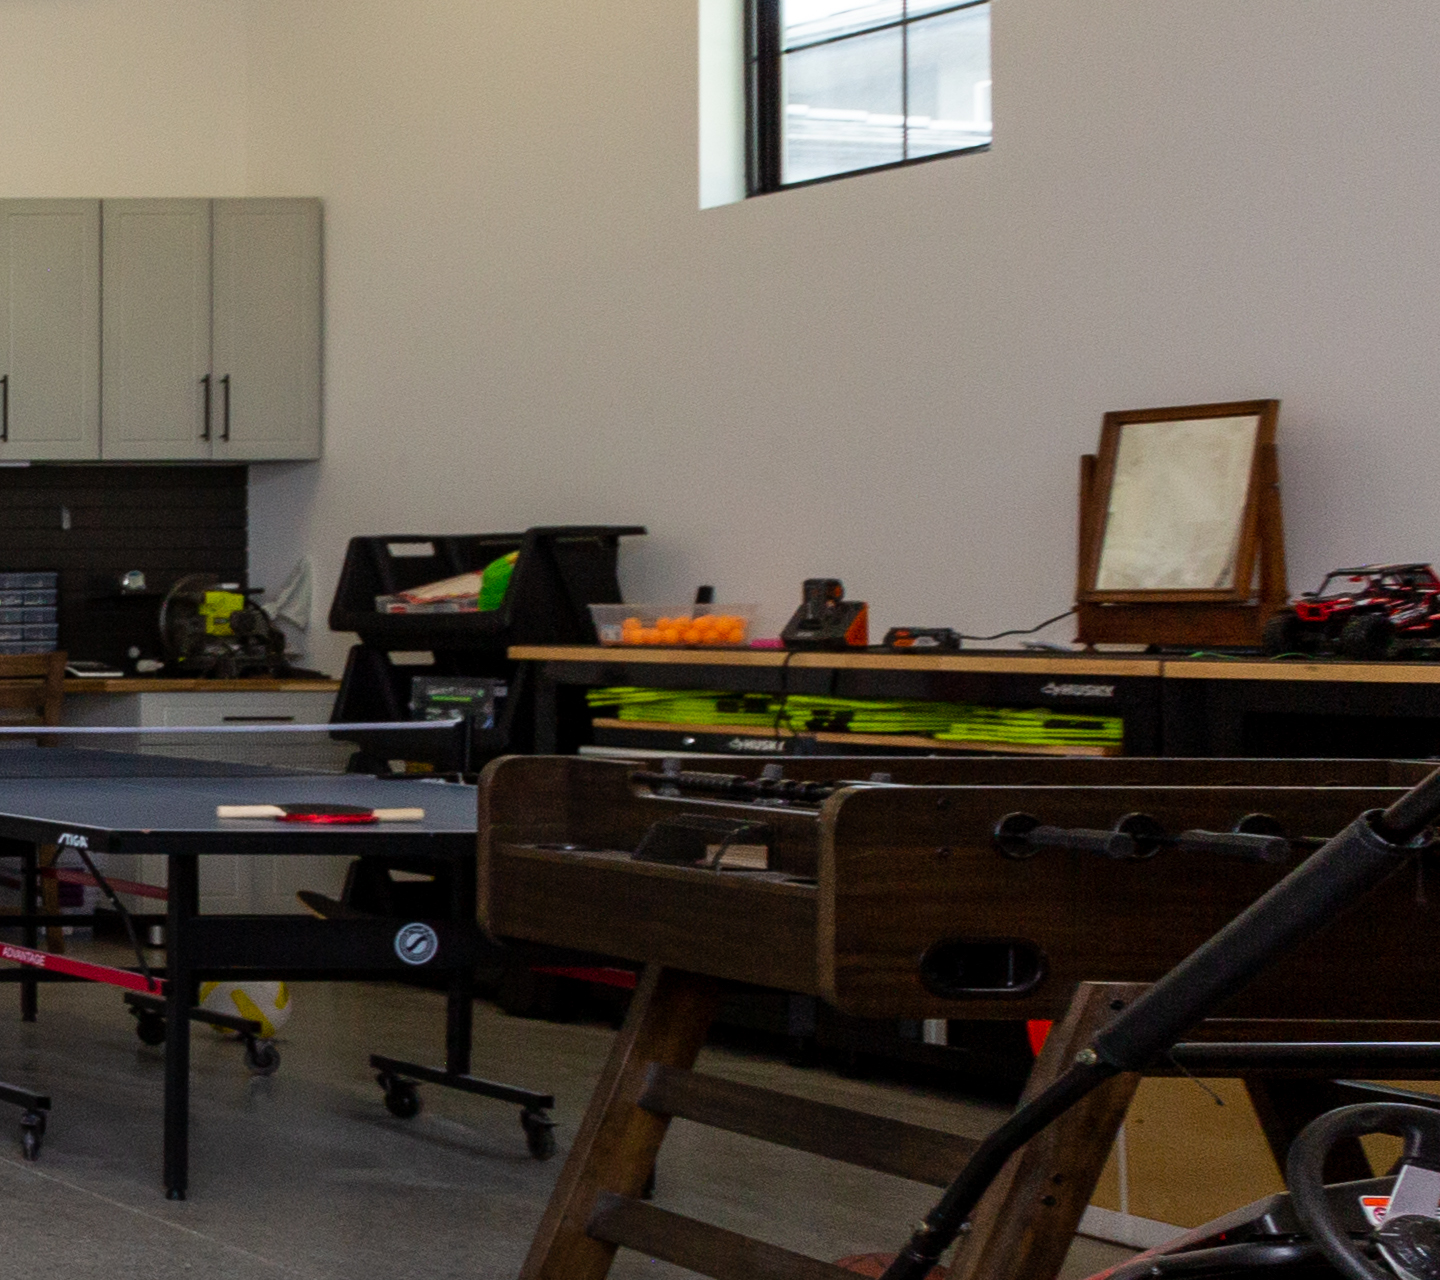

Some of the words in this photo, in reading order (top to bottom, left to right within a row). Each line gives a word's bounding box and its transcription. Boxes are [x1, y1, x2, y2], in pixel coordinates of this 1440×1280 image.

[1060, 684, 1116, 697] HUSKY
[58, 832, 89, 849] STIGA
[2, 946, 46, 967] ADVANTAGE
